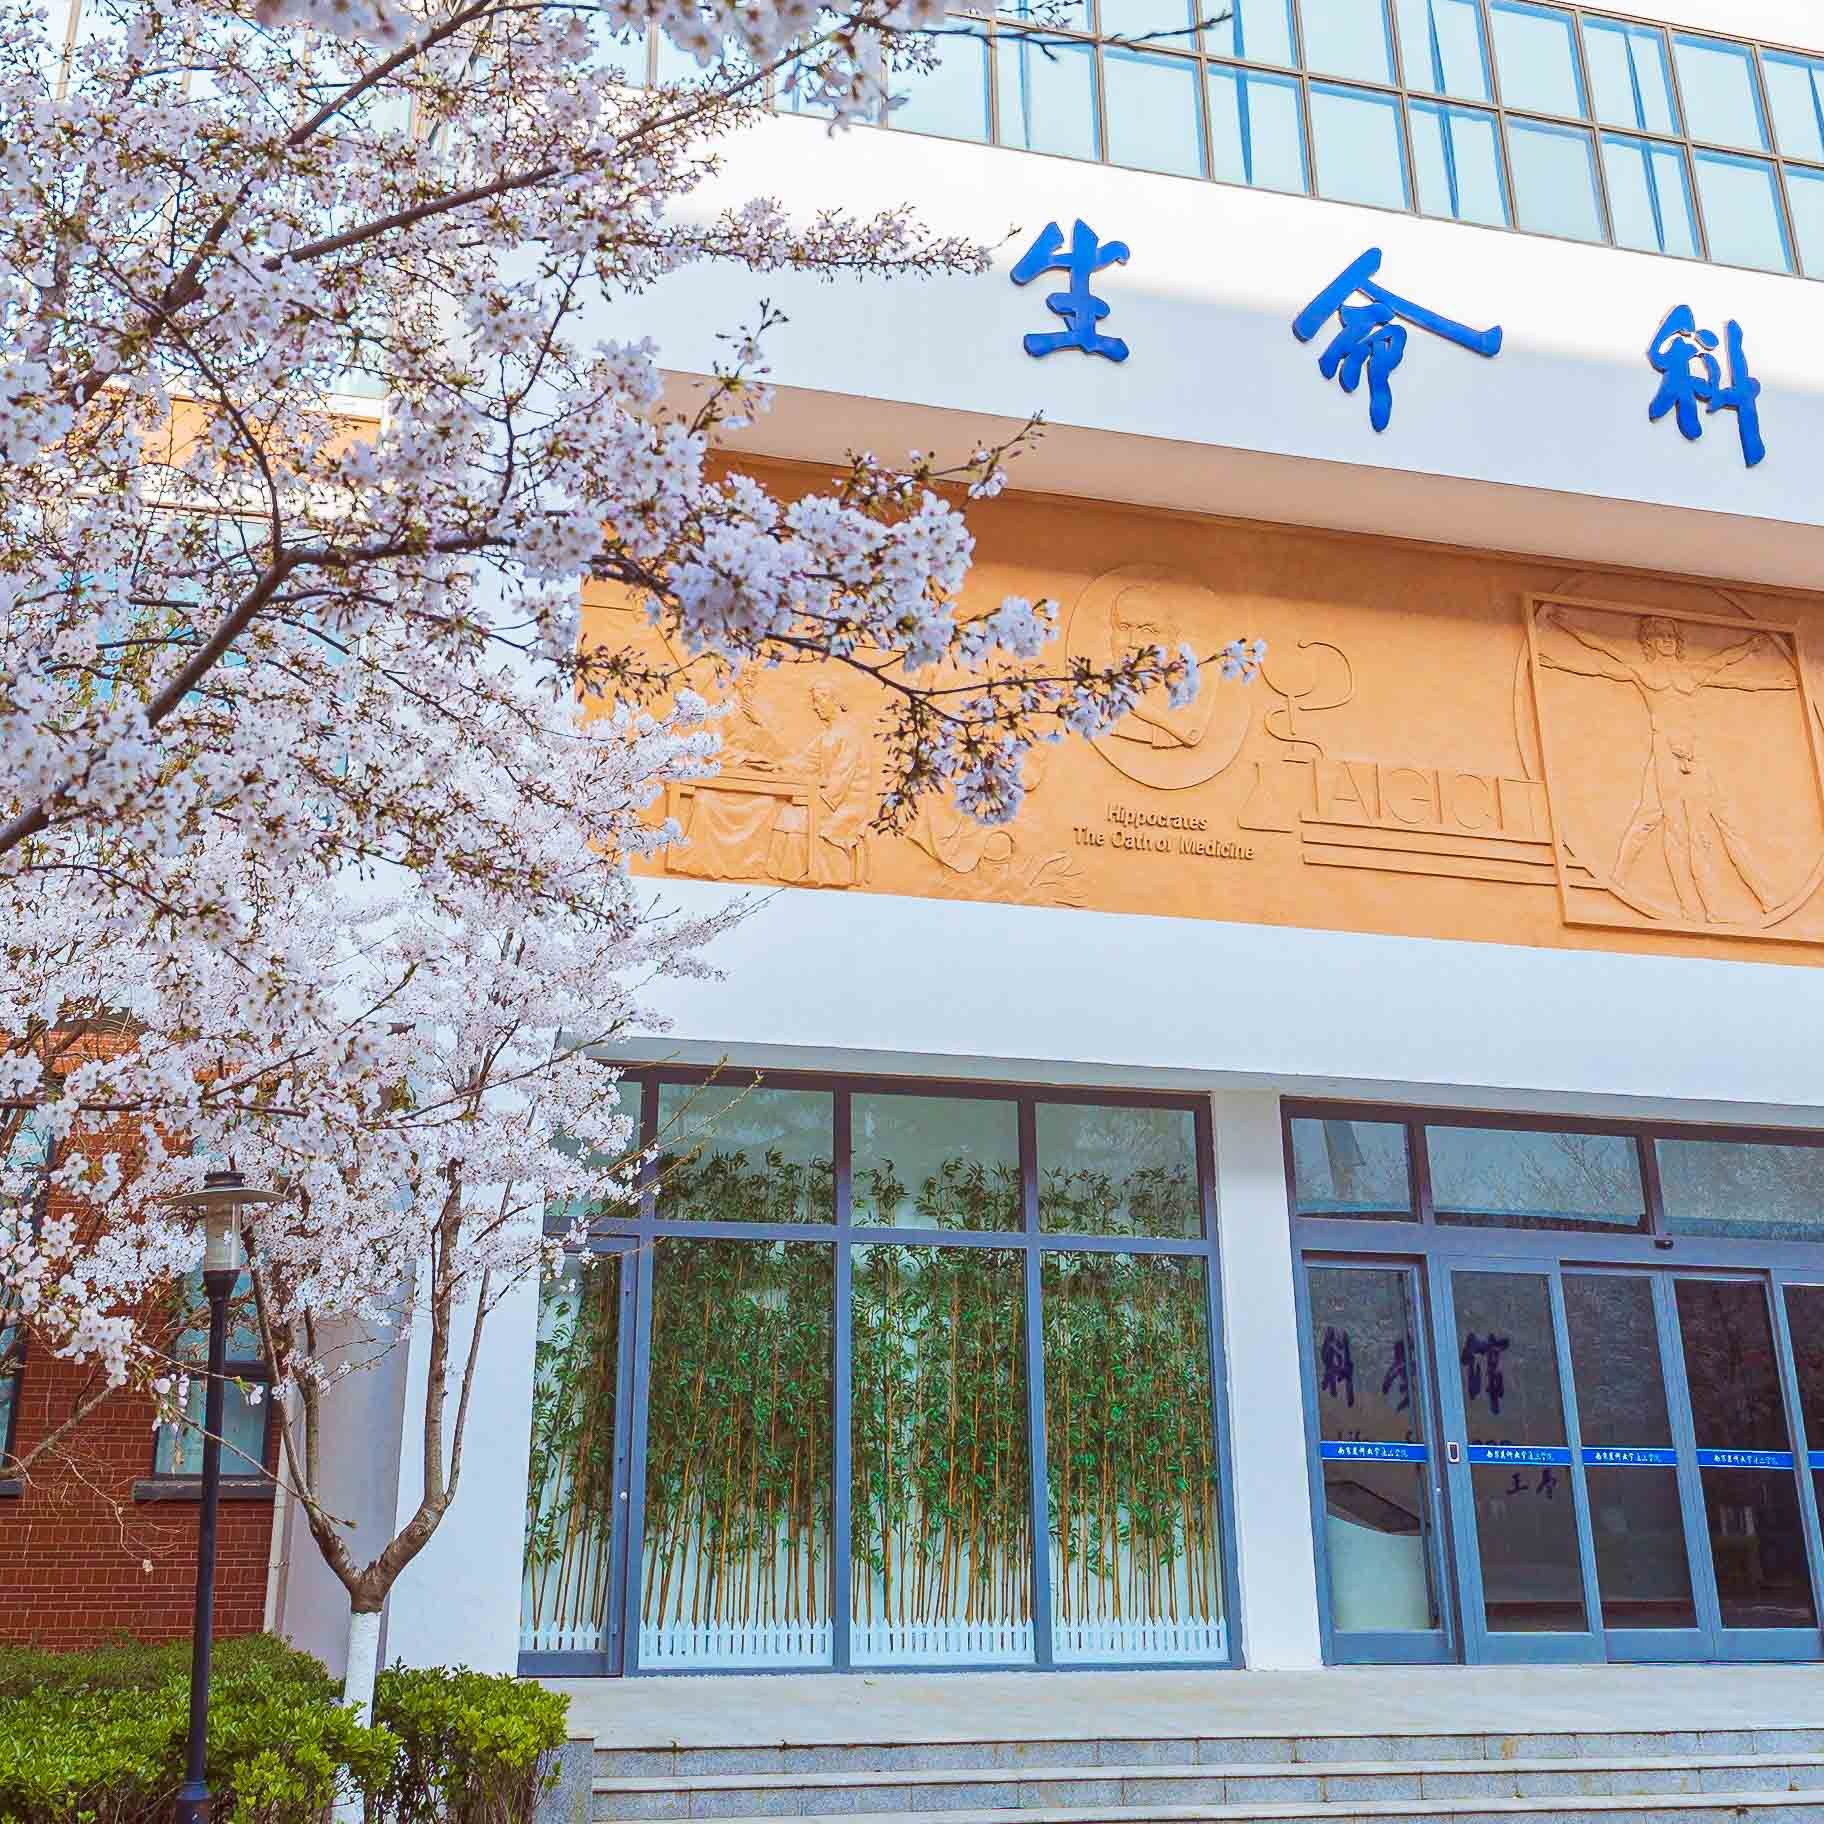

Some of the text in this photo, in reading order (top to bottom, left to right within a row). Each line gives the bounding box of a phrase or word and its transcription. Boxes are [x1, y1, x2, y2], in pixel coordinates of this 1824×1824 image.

[1106, 803, 1208, 830] Hippocrates
[1073, 825, 1104, 847] The
[1111, 830, 1153, 850] Oath
[1179, 834, 1256, 860] Medicine
